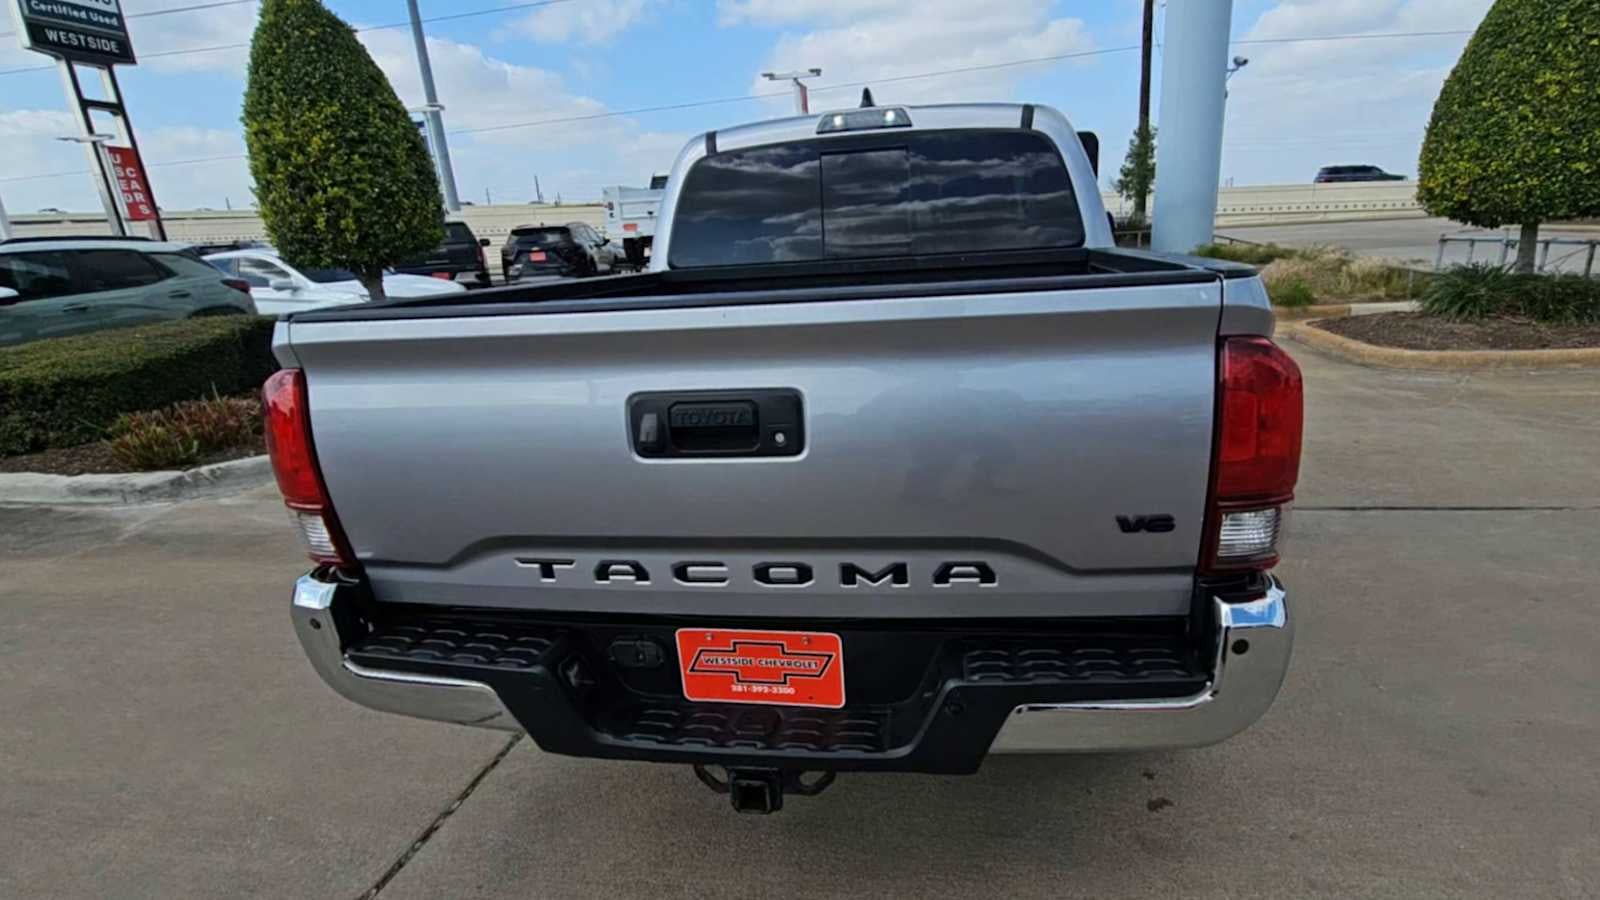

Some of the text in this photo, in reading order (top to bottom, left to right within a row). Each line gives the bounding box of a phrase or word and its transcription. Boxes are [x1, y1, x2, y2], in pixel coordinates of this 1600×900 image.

[30, 0, 119, 26] Certified Used
[44, 28, 120, 53] WESTSIDE
[126, 167, 150, 214] CARS
[674, 408, 752, 424] TOYOTA
[1115, 514, 1176, 533] V6
[514, 557, 999, 588] TACOMA
[703, 656, 819, 669] WESTSIDE CHEVROLET
